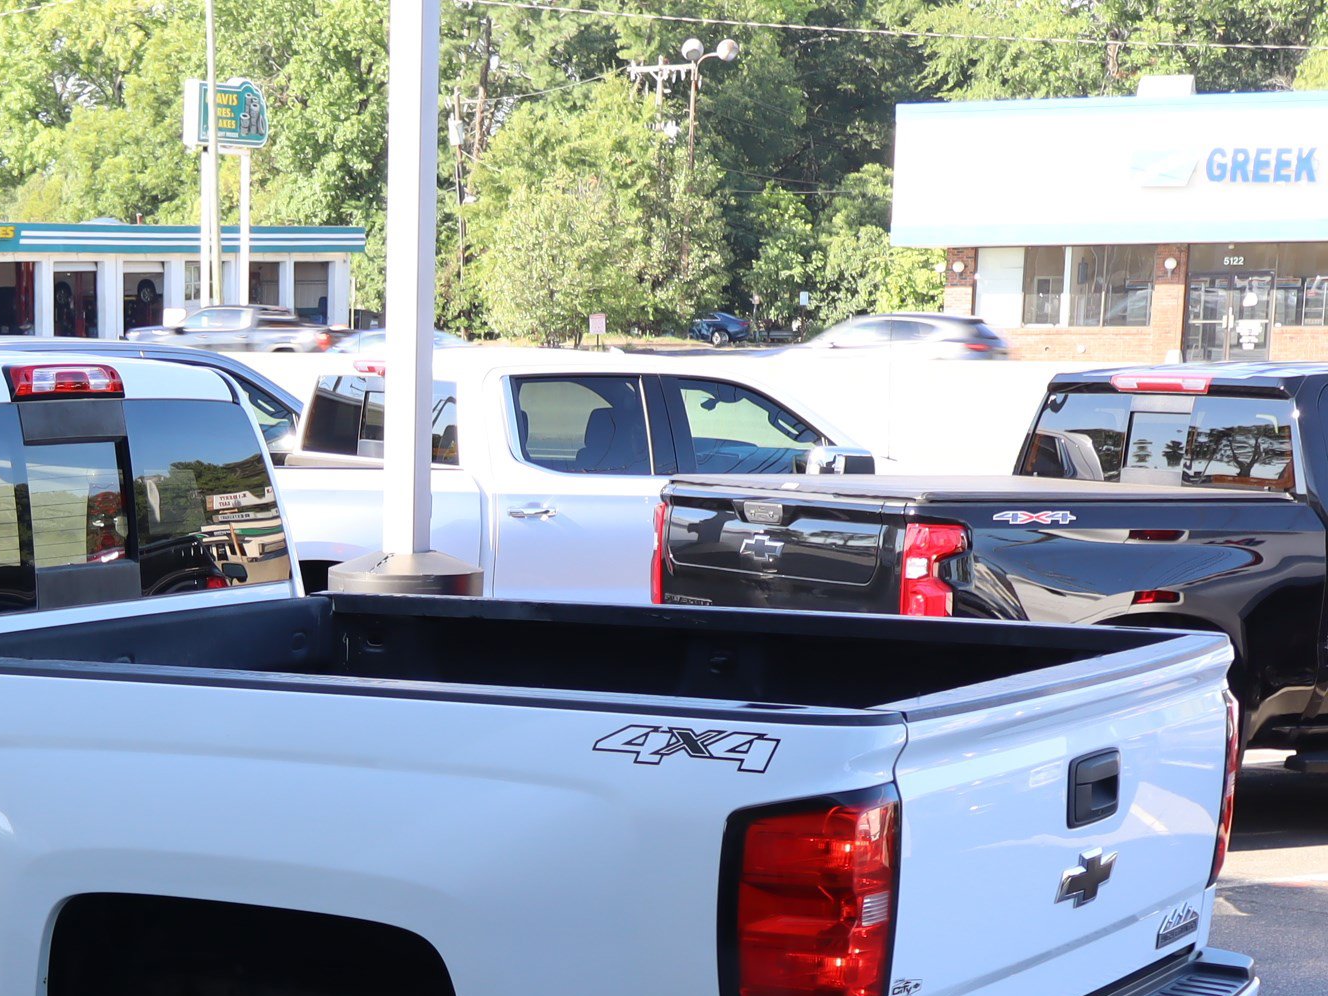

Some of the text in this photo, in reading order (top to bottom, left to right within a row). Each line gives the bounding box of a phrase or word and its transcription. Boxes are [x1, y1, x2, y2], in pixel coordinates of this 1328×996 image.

[206, 93, 238, 106] AVIS
[1205, 147, 1318, 184] GREEK
[1223, 256, 1245, 266] 5122
